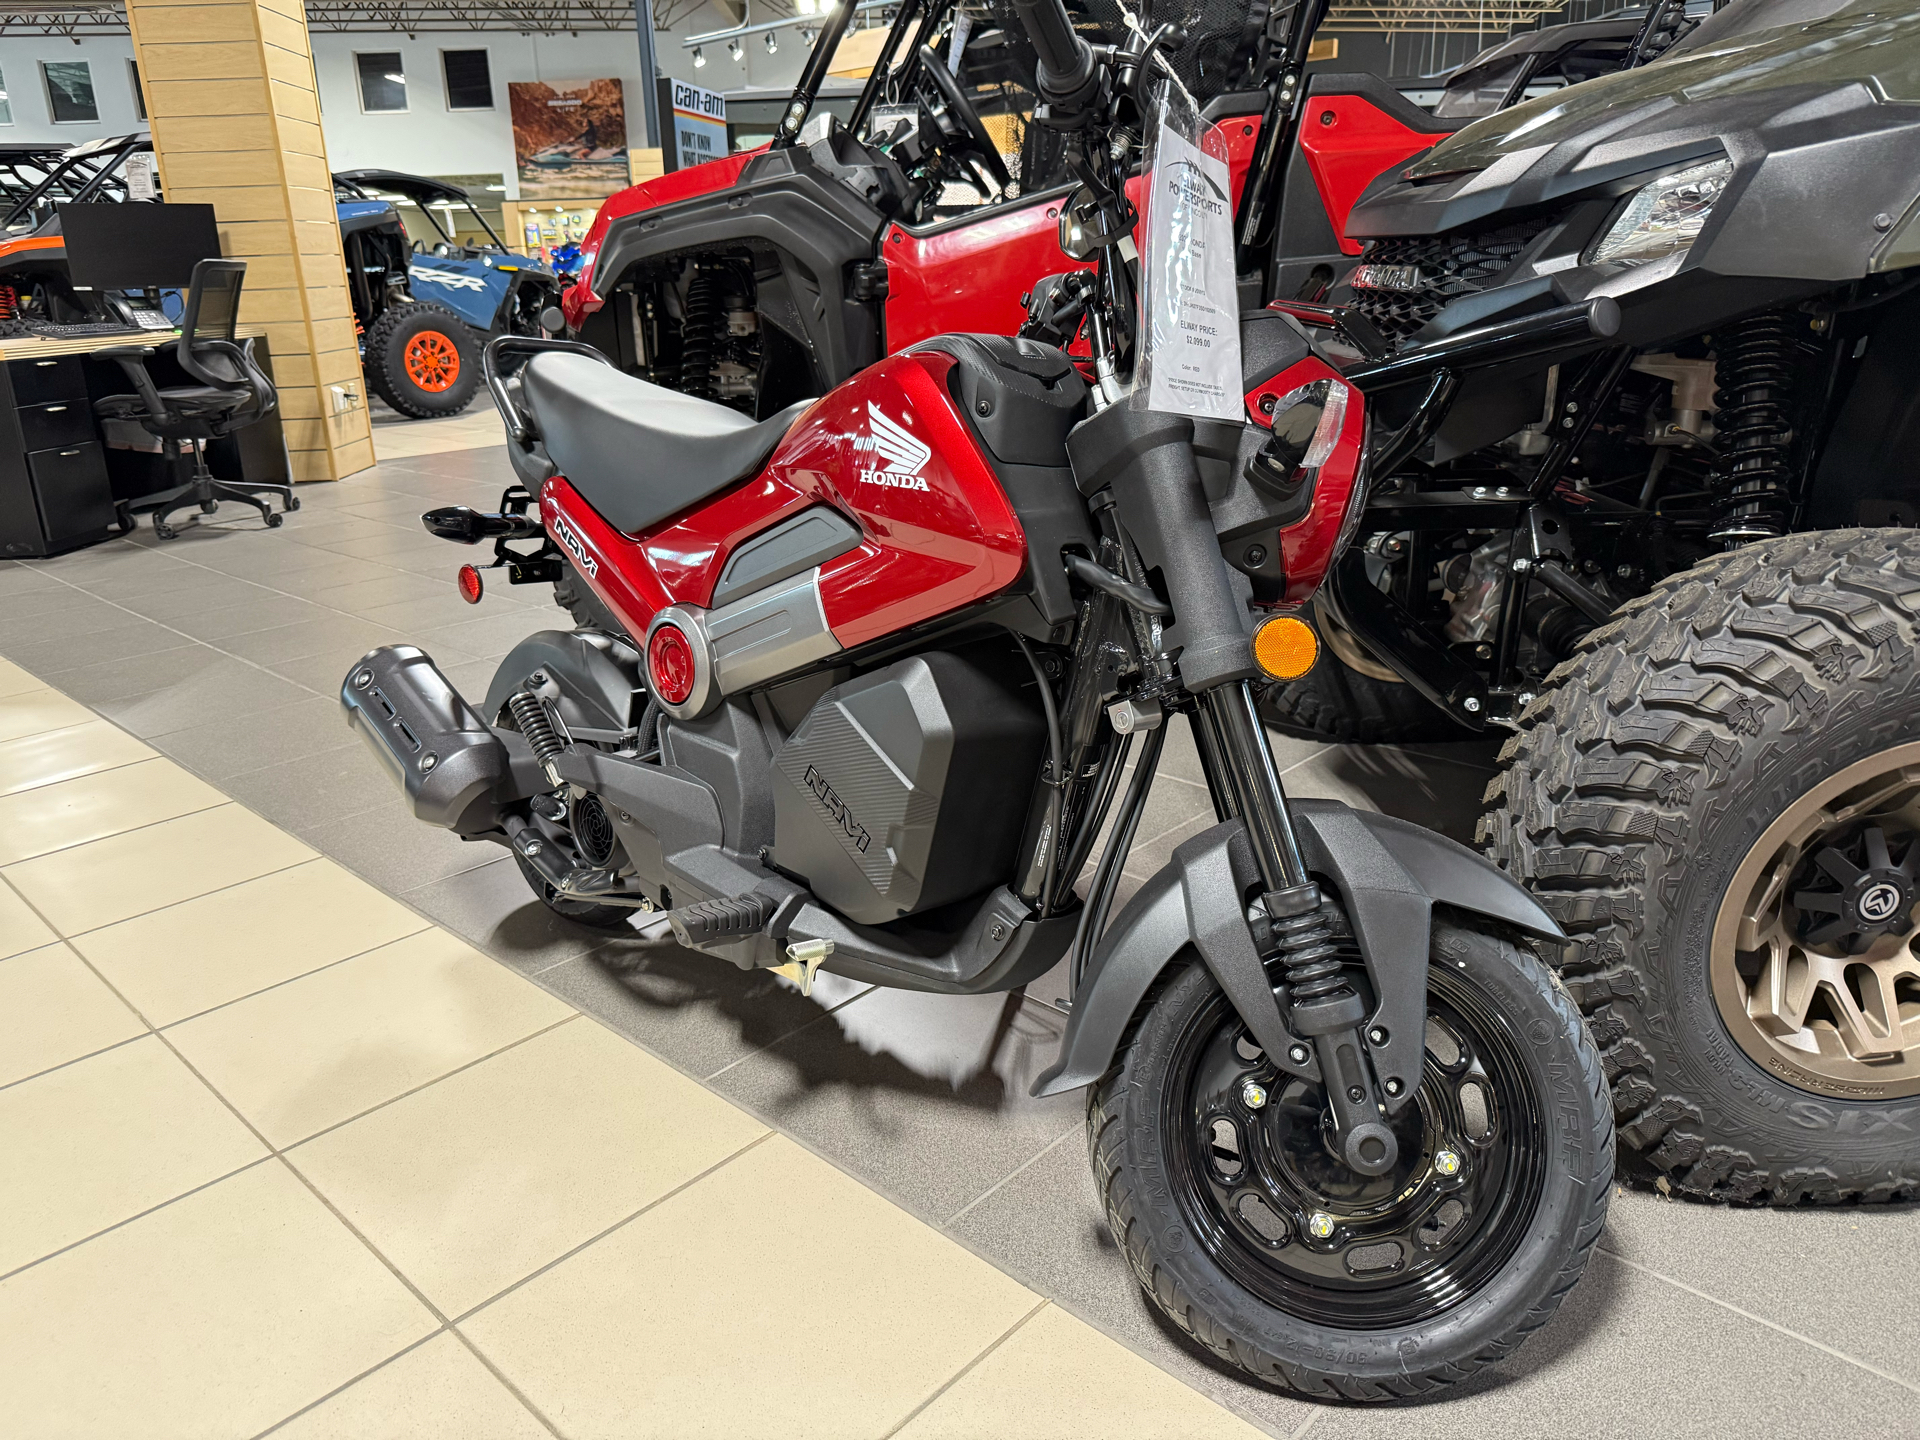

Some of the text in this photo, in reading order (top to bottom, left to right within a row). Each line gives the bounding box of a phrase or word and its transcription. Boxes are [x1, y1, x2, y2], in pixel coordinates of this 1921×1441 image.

[681, 130, 712, 152] DON'T KNOW
[1168, 180, 1222, 215] POWERSPORTS
[408, 265, 489, 292] RZR
[1180, 320, 1218, 336] ELWAY PRICE:
[860, 469, 931, 492] HONDA
[1706, 1028, 1736, 1069] RADIAL
